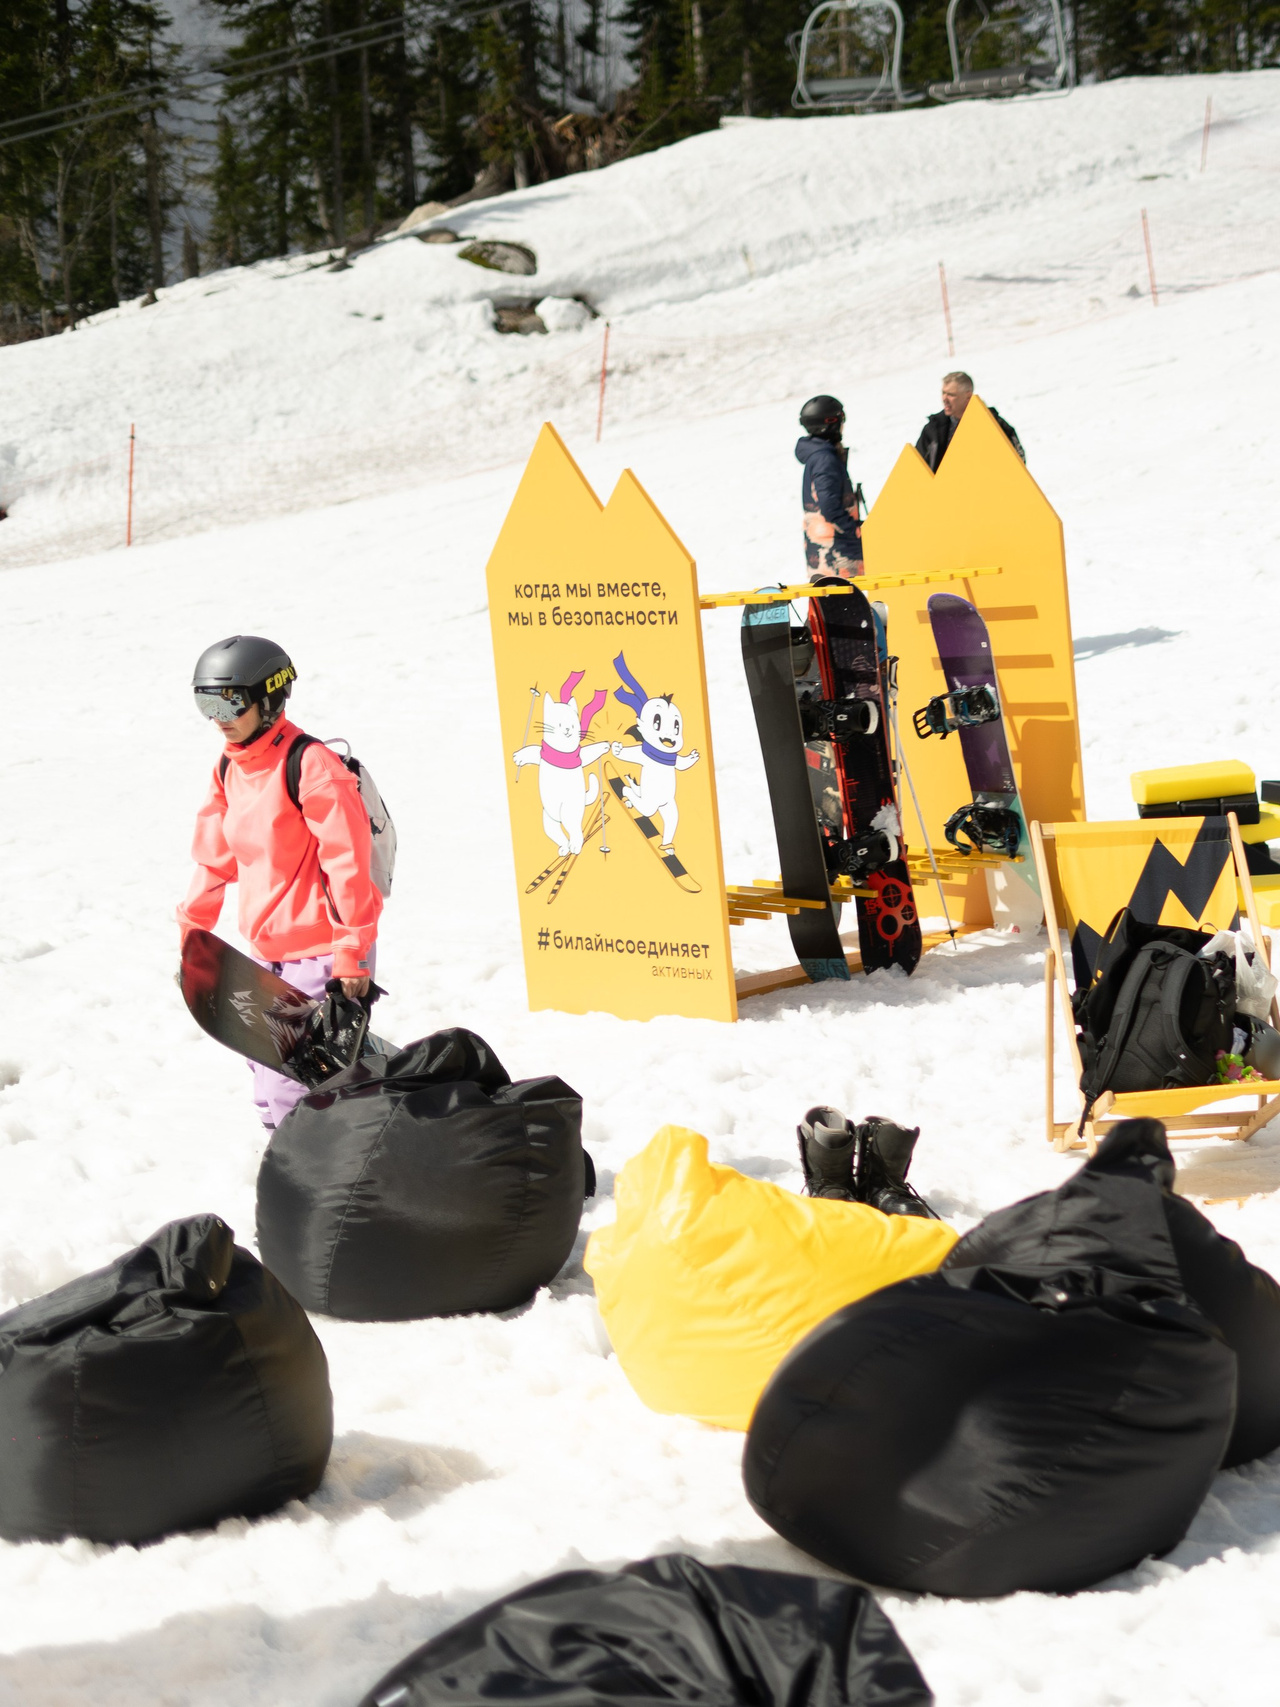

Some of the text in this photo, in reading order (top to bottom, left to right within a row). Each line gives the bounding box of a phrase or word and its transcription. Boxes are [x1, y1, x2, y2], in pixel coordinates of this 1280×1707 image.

[514, 581, 667, 602] когда мы вместе,
[508, 606, 678, 626] мы в безопасности
[537, 926, 710, 959] #билайнсоединяет
[651, 965, 713, 981] активных
